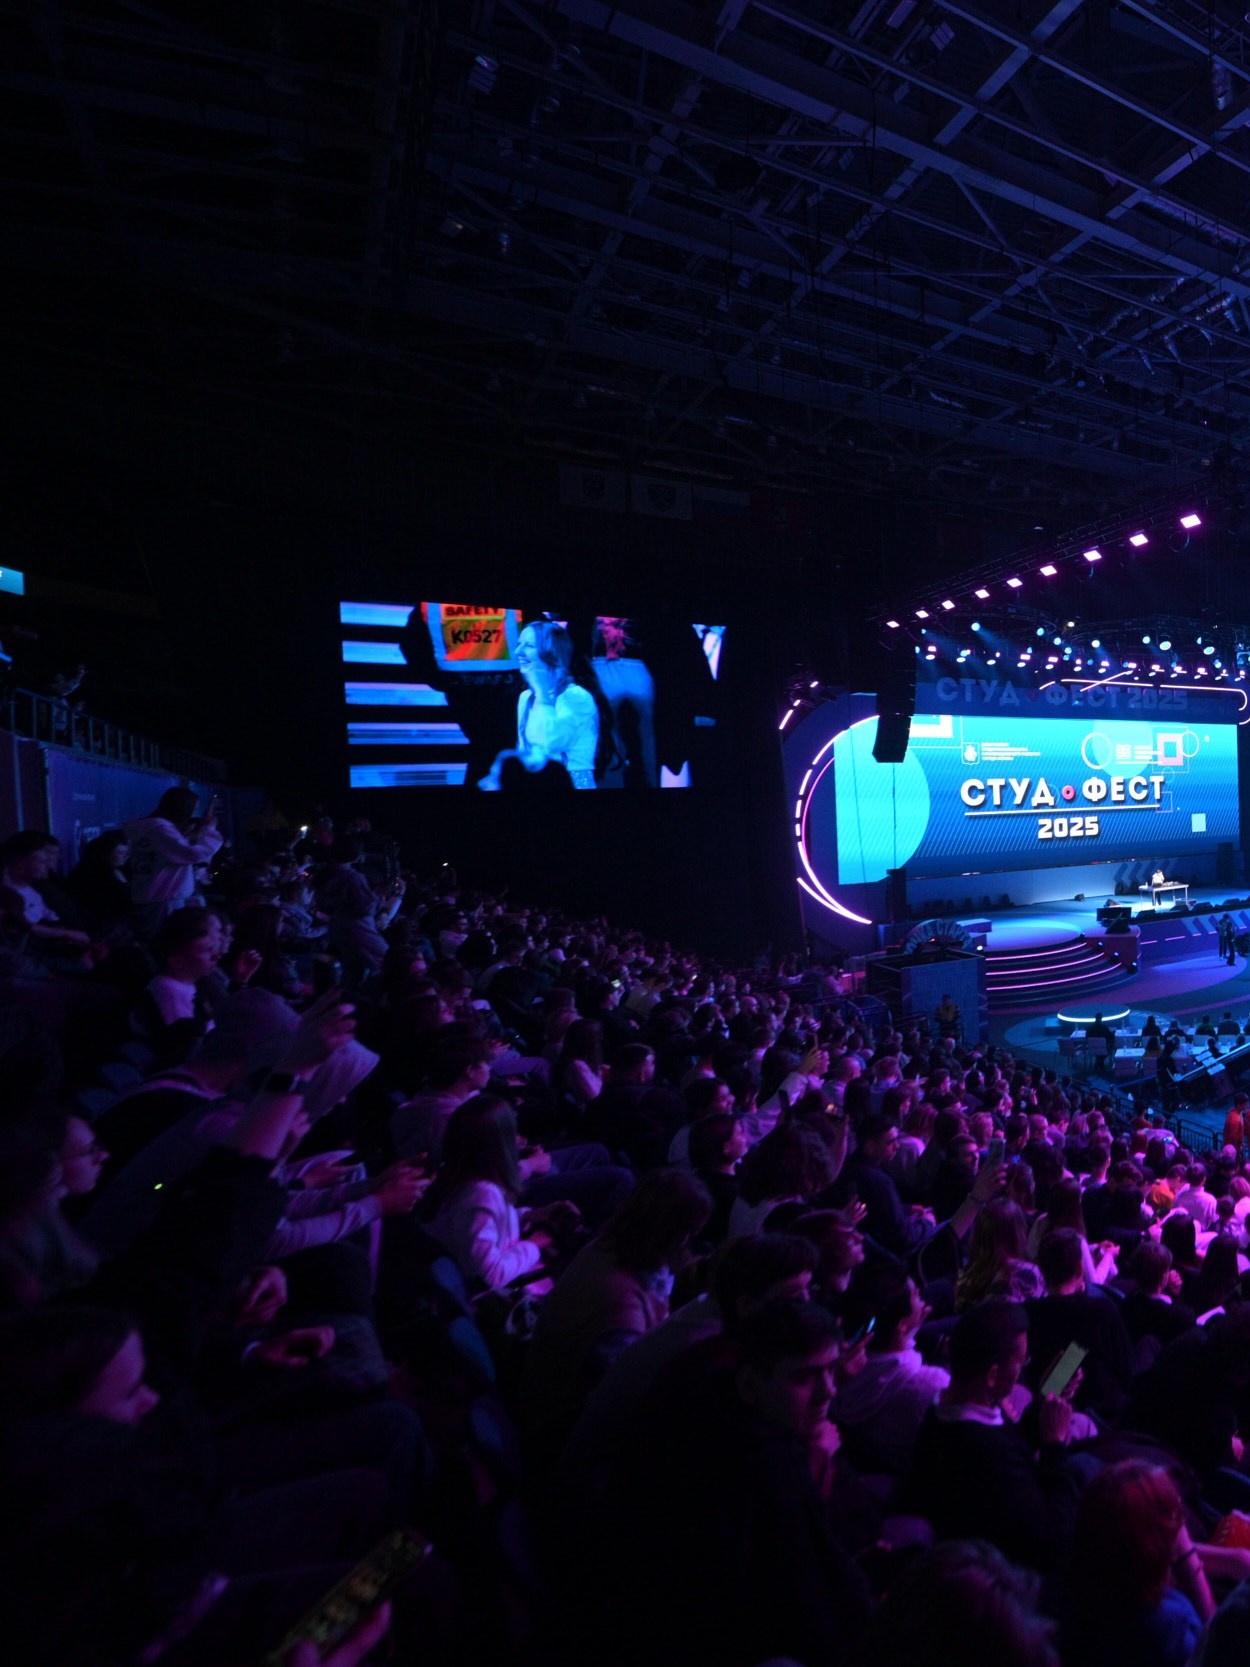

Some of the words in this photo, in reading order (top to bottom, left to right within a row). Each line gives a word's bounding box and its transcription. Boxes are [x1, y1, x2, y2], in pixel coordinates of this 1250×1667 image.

[451, 629, 502, 645] K0527
[936, 677, 1021, 707] СТУД
[1045, 683, 1120, 709] ФЕСТ
[1126, 688, 1189, 711] 2025
[960, 777, 1056, 807] СТУД
[1082, 775, 1166, 802] ФЕСТ
[1037, 816, 1100, 840] 2025
